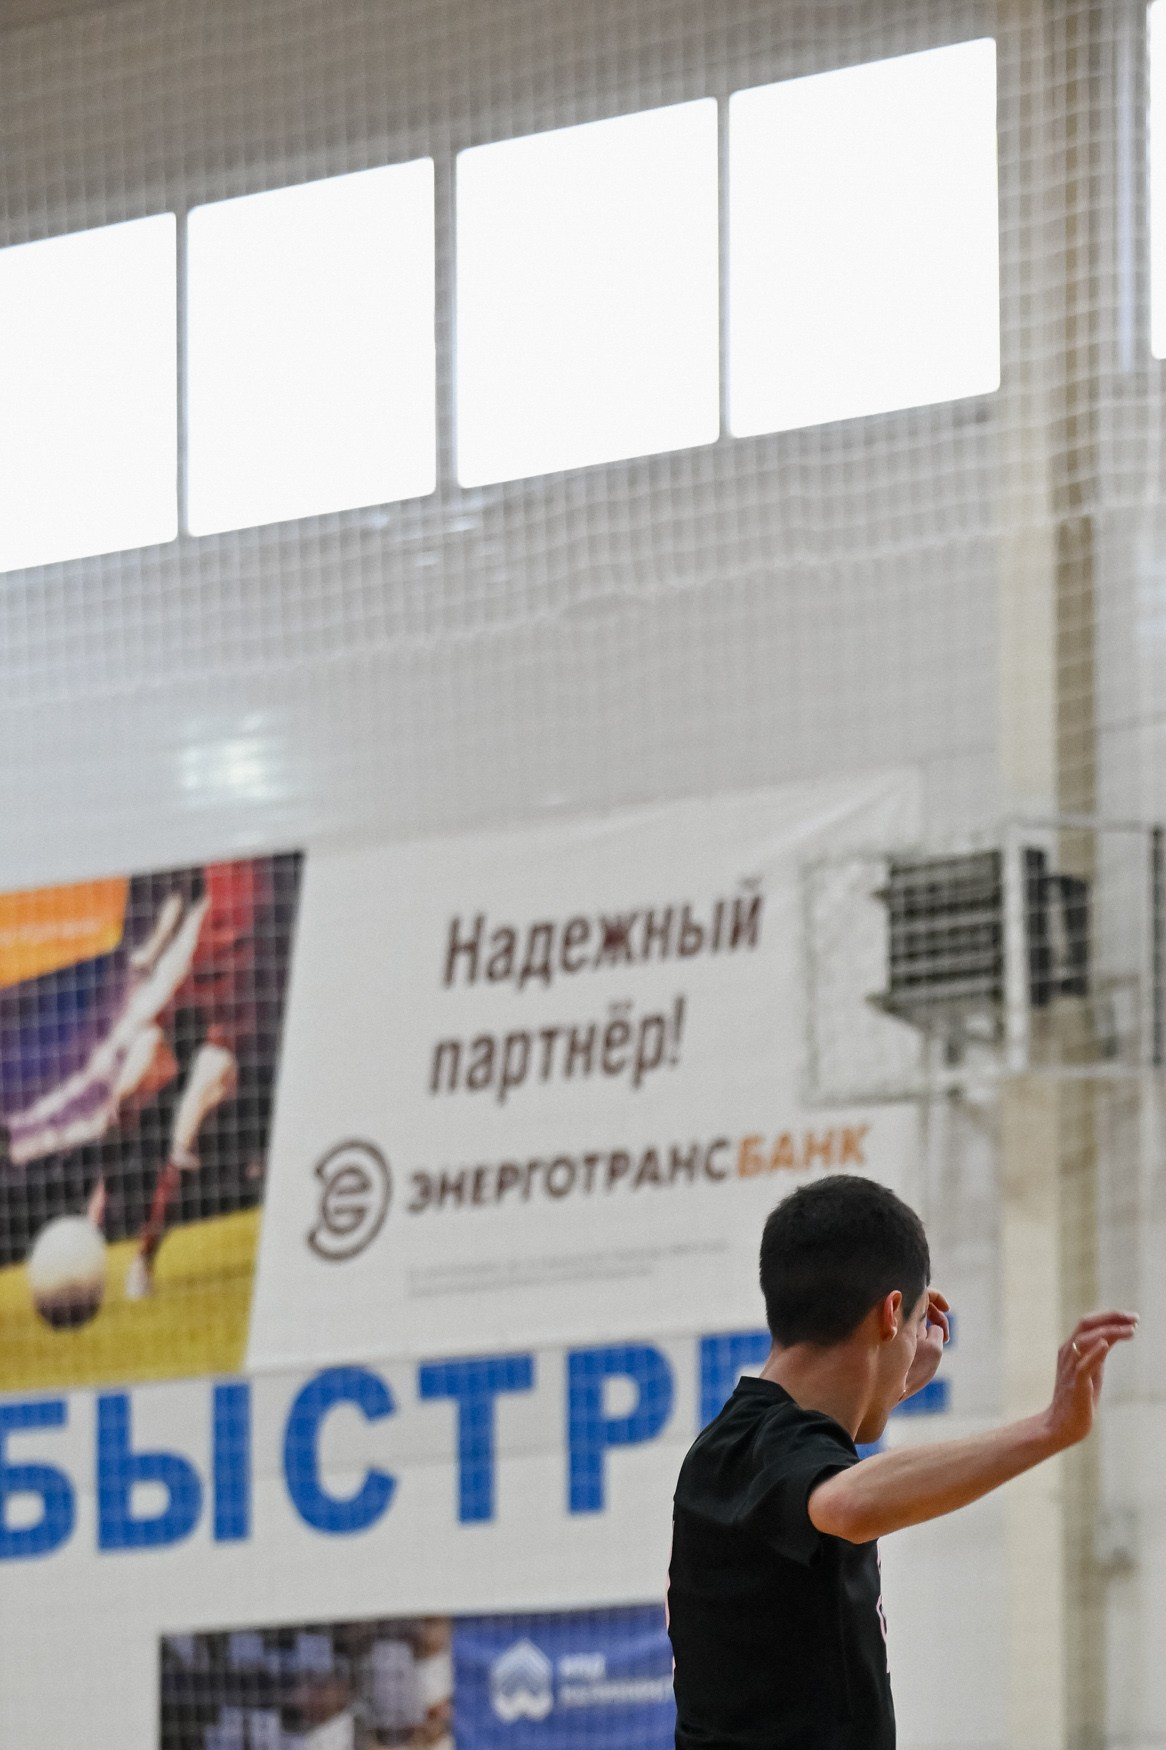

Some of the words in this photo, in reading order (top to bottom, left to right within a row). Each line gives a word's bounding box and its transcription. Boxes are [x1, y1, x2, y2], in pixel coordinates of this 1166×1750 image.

[444, 880, 764, 989] Надежный
[430, 997, 687, 1104] партнёр!
[408, 1123, 872, 1214] ЭНЕРГОТРАНСБАНК
[0, 1314, 954, 1561] БЫСТР
